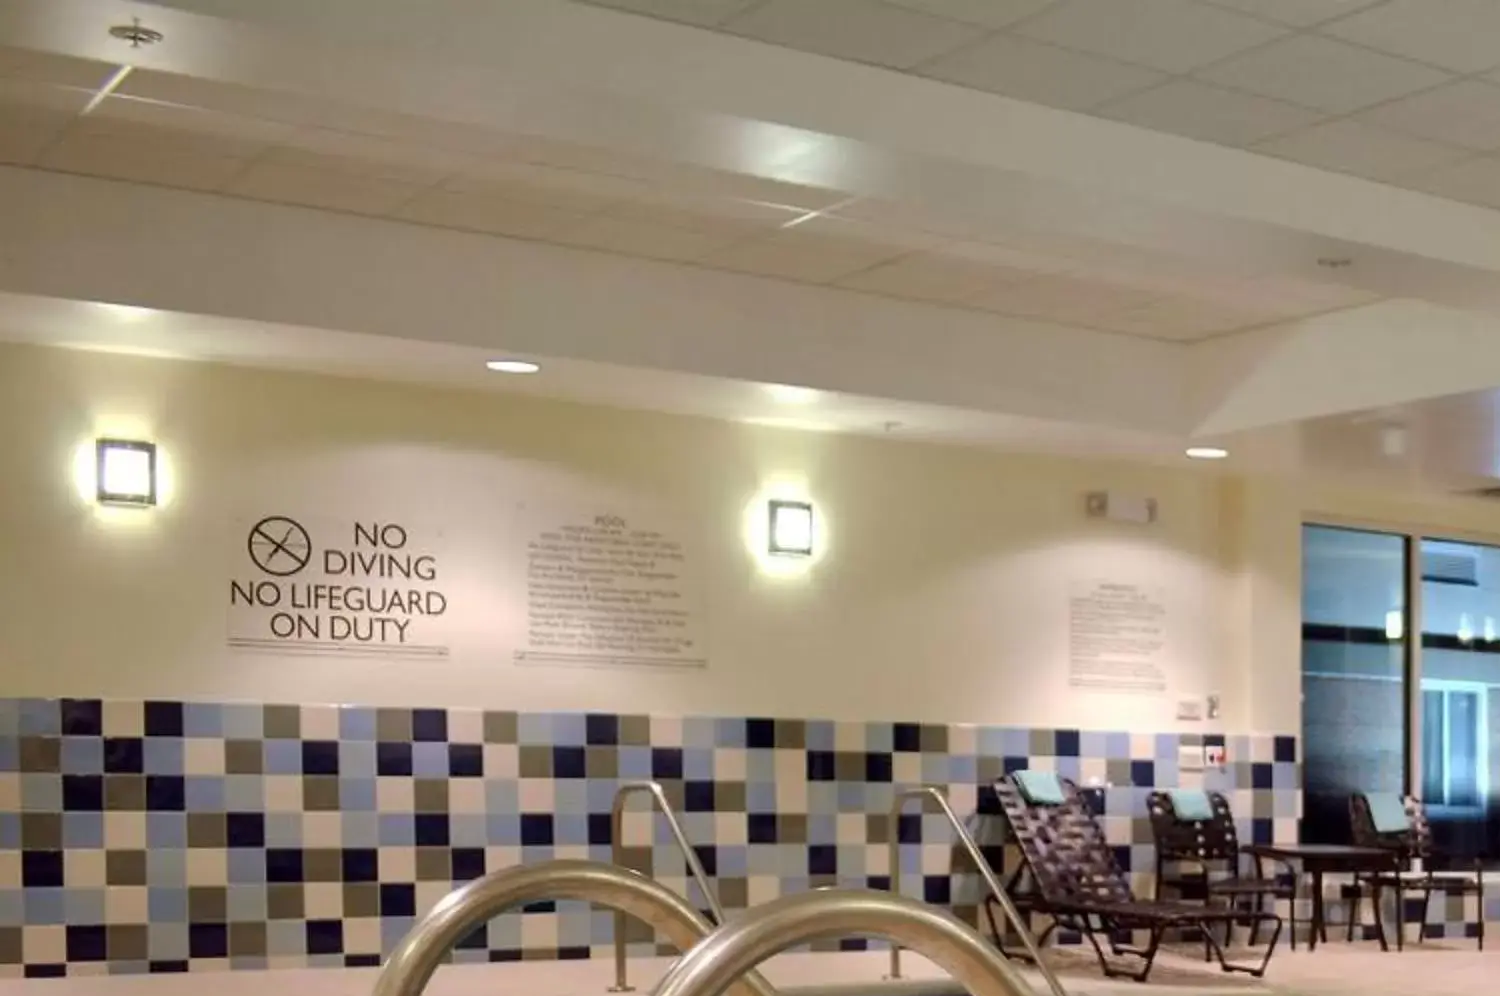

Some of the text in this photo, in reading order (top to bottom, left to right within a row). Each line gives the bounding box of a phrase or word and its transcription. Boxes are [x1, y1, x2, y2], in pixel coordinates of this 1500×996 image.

[354, 521, 407, 549] NO
[323, 549, 437, 581] DIVING
[230, 579, 448, 616] NO LIFEGUARD
[269, 611, 411, 643] ON DUTY
